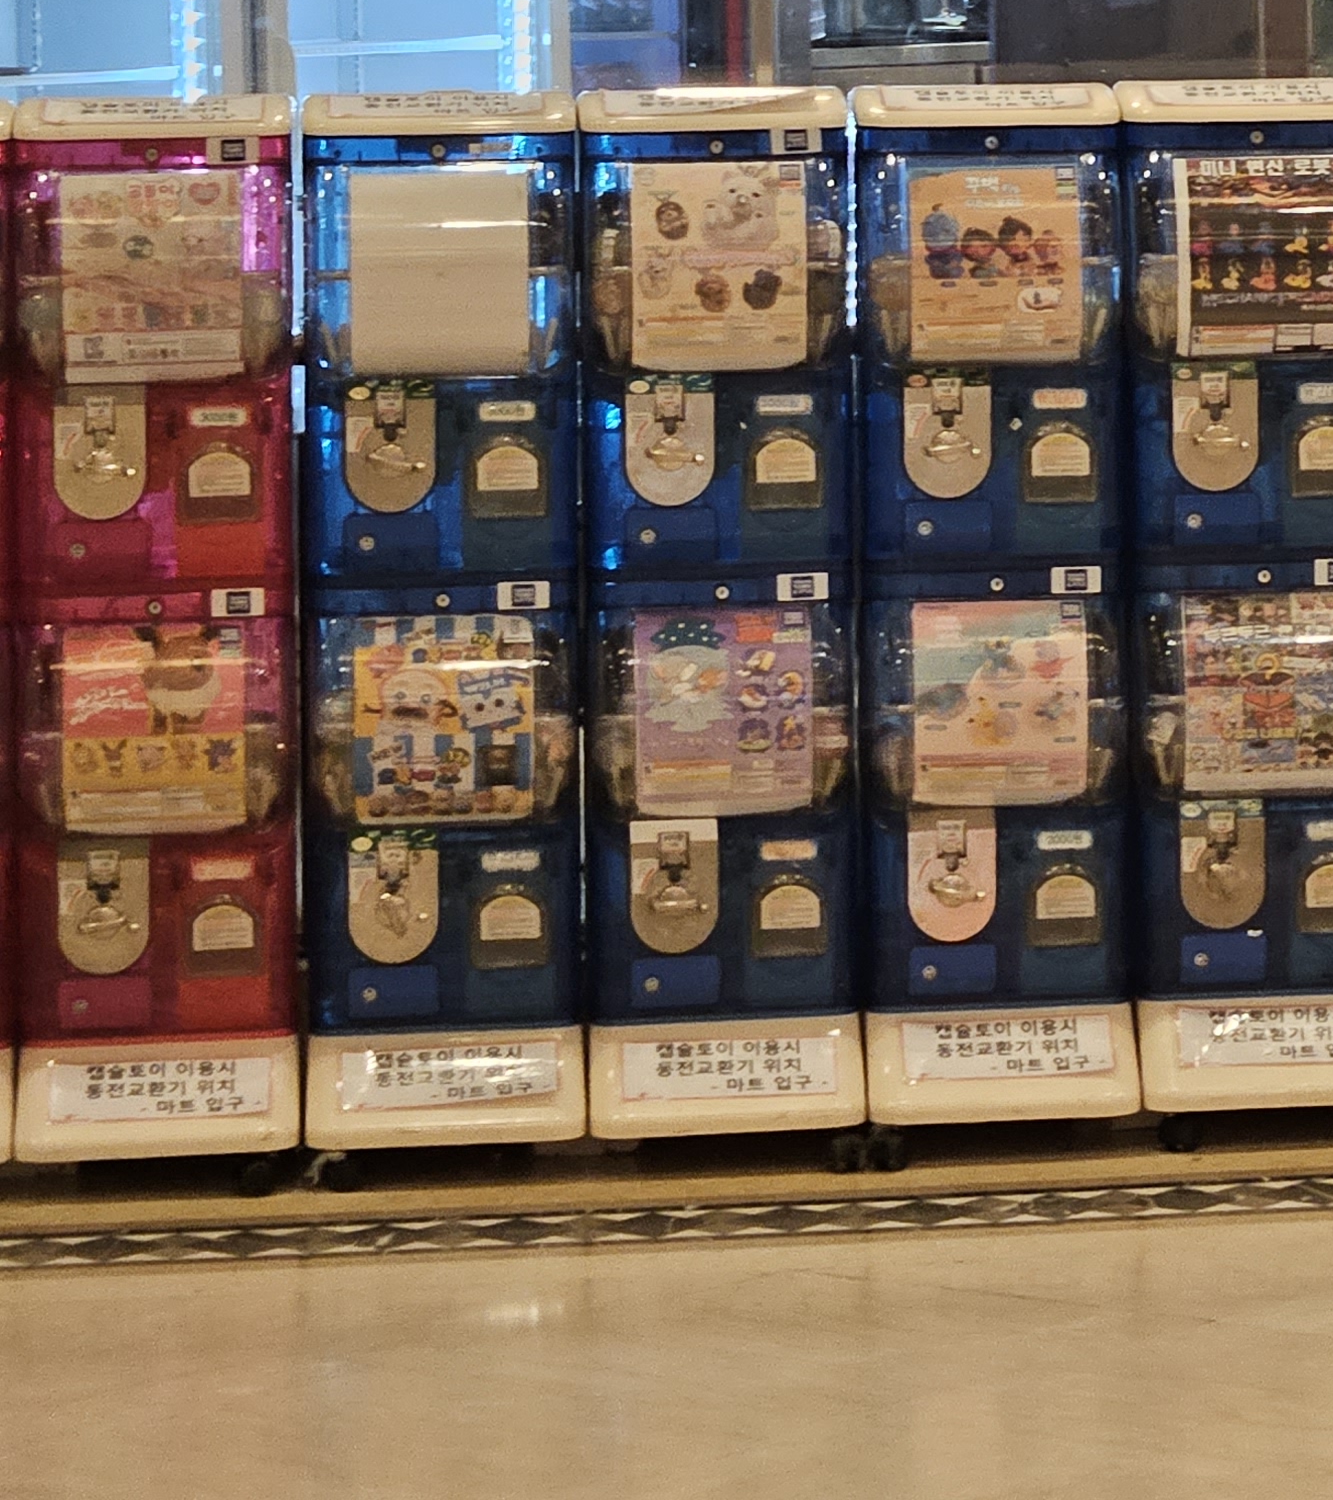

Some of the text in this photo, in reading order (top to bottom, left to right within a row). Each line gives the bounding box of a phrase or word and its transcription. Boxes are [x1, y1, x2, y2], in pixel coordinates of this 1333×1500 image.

[1200, 158, 1331, 176] 미니 변신 로봇
[935, 1018, 1078, 1039] 캡슐토이 이용시
[656, 1040, 802, 1058] 캡슐토이 이용시
[936, 1038, 1079, 1059] 동전교환기 위치
[86, 1060, 237, 1081] 캡슐토이 이용시
[656, 1057, 802, 1077] 동전교환기 위치
[1005, 1055, 1090, 1073] 마트 입구
[85, 1079, 235, 1098] 동전교환기 위치
[726, 1075, 814, 1093] 마트 입구
[156, 1097, 246, 1115] 마트 입구
